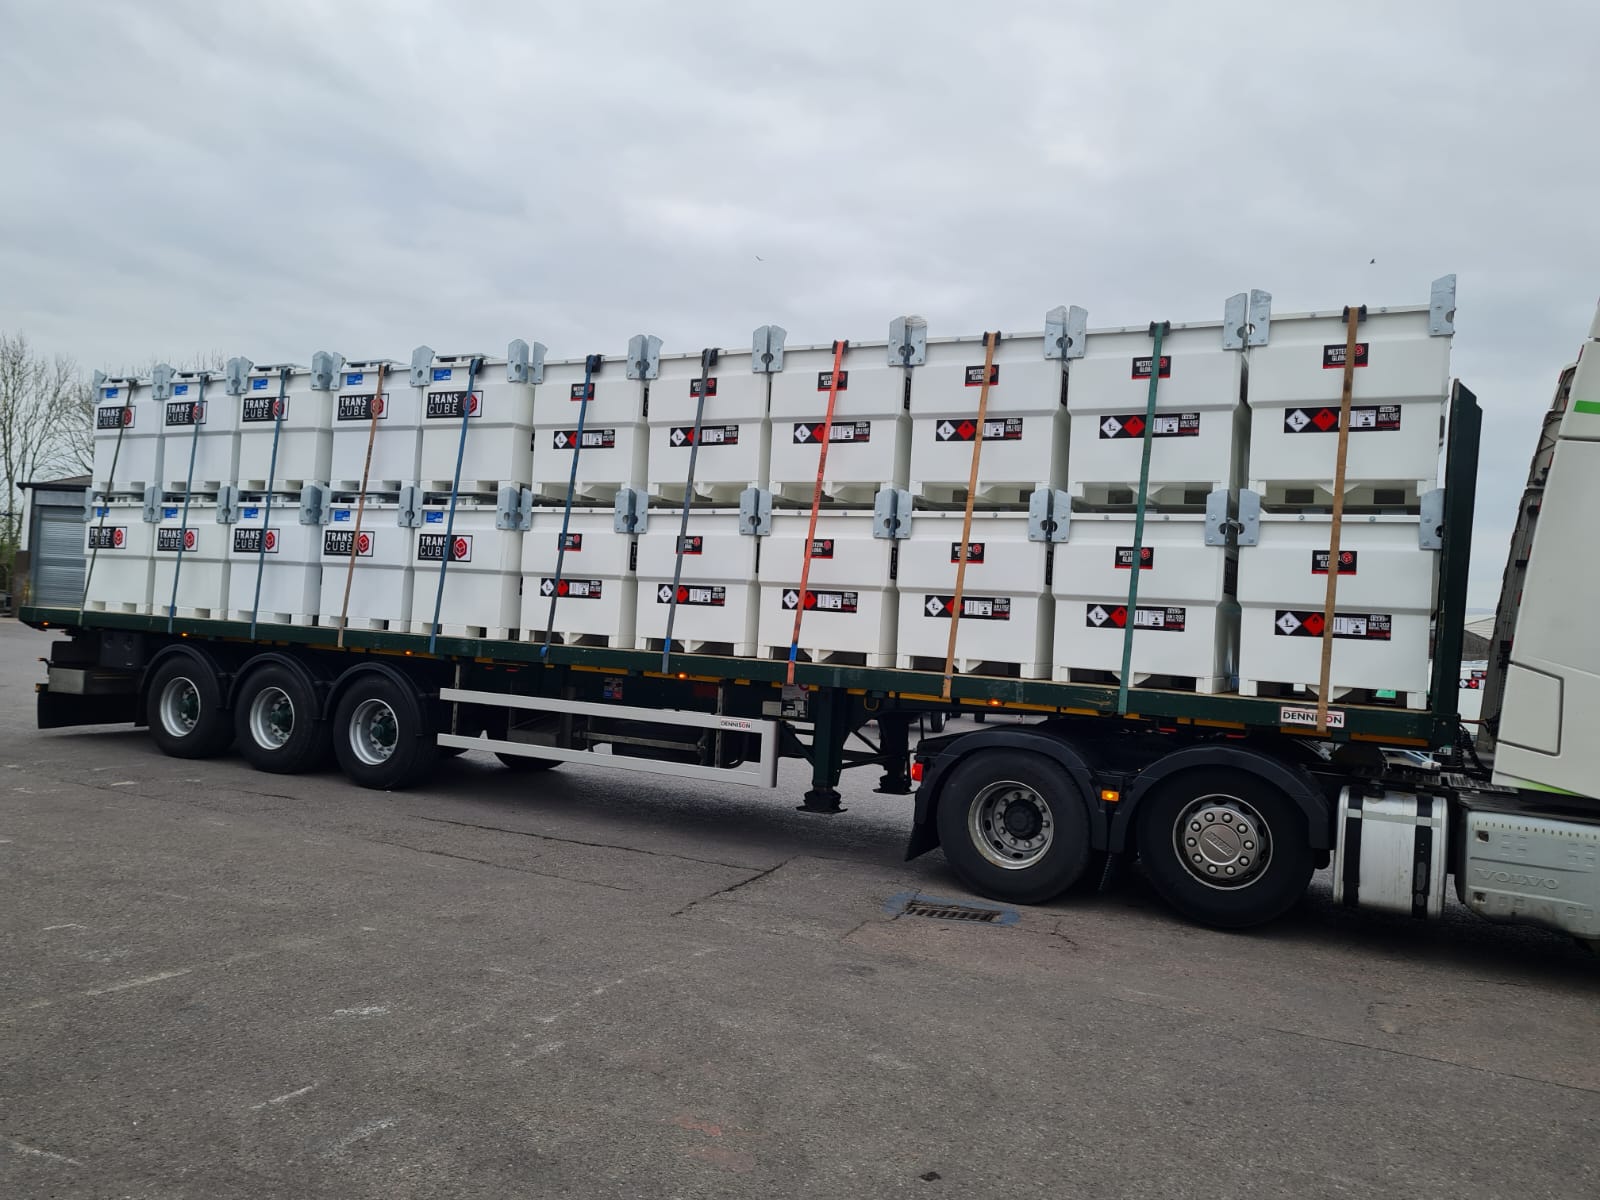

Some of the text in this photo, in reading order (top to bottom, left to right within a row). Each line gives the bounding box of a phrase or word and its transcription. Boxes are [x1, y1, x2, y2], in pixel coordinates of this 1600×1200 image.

[245, 399, 269, 408] TRANS
[341, 397, 367, 406] TRANS
[429, 394, 459, 404] TRANS
[99, 408, 120, 417] TRANS
[168, 404, 190, 413] TRANS
[244, 408, 268, 418] CUBE
[340, 406, 366, 416] CUBE
[428, 403, 457, 414] CUBE
[98, 416, 120, 425] CUBE
[167, 412, 189, 422] CUBE
[160, 529, 181, 538] TRANS
[236, 530, 259, 539] TRANS
[327, 532, 353, 542] TRANS
[159, 538, 181, 547] CUBE
[234, 539, 258, 549] CUBE
[326, 541, 352, 551] CUBE
[420, 546, 445, 556] CUB
[1283, 711, 1342, 724] DENNION
[721, 720, 751, 729] DENNISON
[1474, 868, 1559, 889] VOLVO
